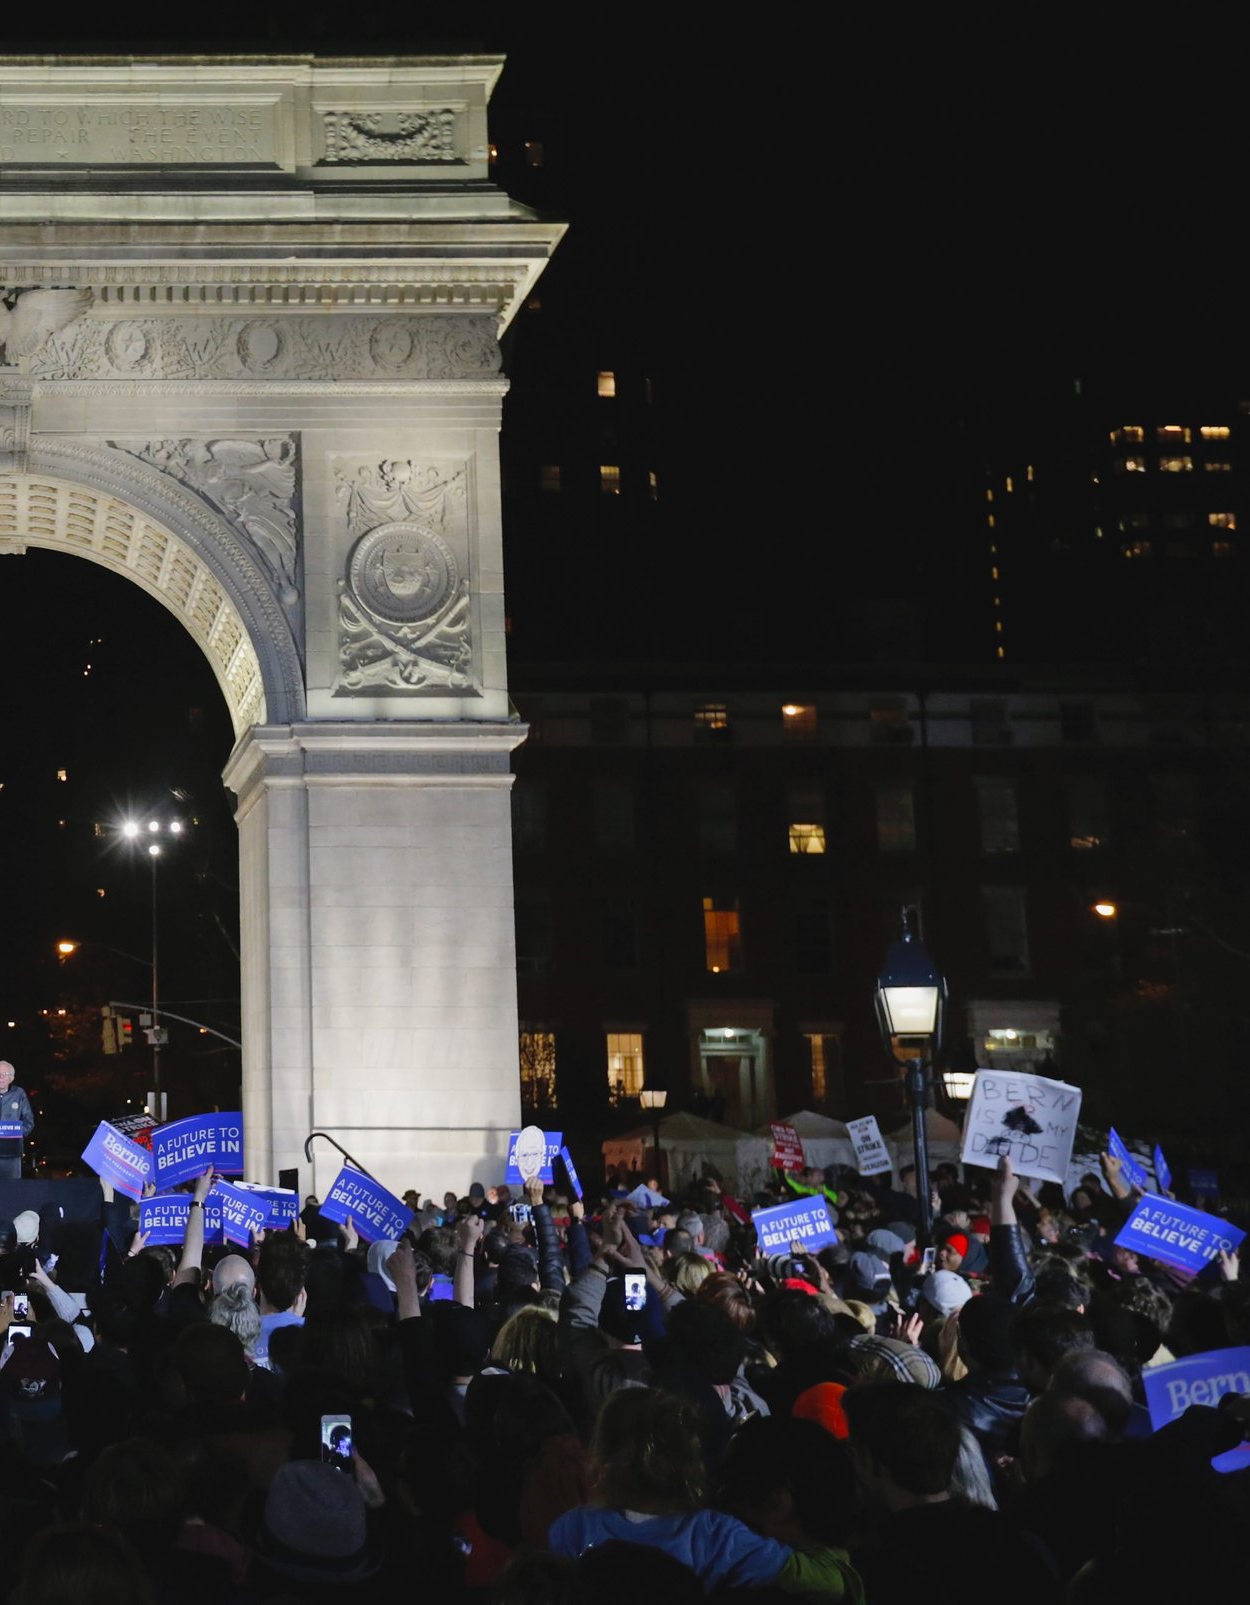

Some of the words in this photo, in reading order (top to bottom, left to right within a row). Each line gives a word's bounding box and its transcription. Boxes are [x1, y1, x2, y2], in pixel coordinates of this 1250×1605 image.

[38, 110, 69, 126] TO
[76, 110, 150, 126] WHICH
[157, 110, 201, 126] THE
[209, 110, 263, 126] WISE
[13, 128, 89, 144] REPAIR
[129, 128, 174, 144] THE
[186, 128, 263, 144] EVENT
[110, 147, 263, 162] WASHINGTON
[982, 1079, 1075, 1112] BERN
[975, 1106, 996, 1124] IS
[1046, 1121, 1069, 1136] MY
[157, 1144, 166, 1155] A
[167, 1128, 215, 1149] FUTURE
[219, 1127, 240, 1139] TO
[549, 1145, 559, 1154] TO
[102, 1132, 150, 1175] Bernie
[158, 1141, 216, 1170] BELIEVE
[221, 1140, 240, 1153] IN
[144, 1208, 153, 1217] A
[205, 1207, 221, 1217] TO
[282, 1201, 297, 1209] TO
[337, 1178, 346, 1188] A
[346, 1182, 390, 1217] FUTURE
[390, 1212, 404, 1229] TO
[251, 1208, 264, 1222] TO
[282, 1209, 297, 1218] IN
[330, 1188, 384, 1227] BELIEVE
[382, 1223, 399, 1240] IN
[761, 1224, 769, 1234] A
[769, 1212, 810, 1231] FUTURE
[811, 1208, 826, 1220] TO
[205, 1218, 221, 1228] IN
[1138, 1207, 1149, 1218] A
[1151, 1211, 1208, 1240] FUTURE
[1212, 1233, 1232, 1251] TO
[763, 1223, 815, 1247] BELIEVE
[815, 1220, 831, 1233] IN
[1131, 1217, 1202, 1253] BELIEVE
